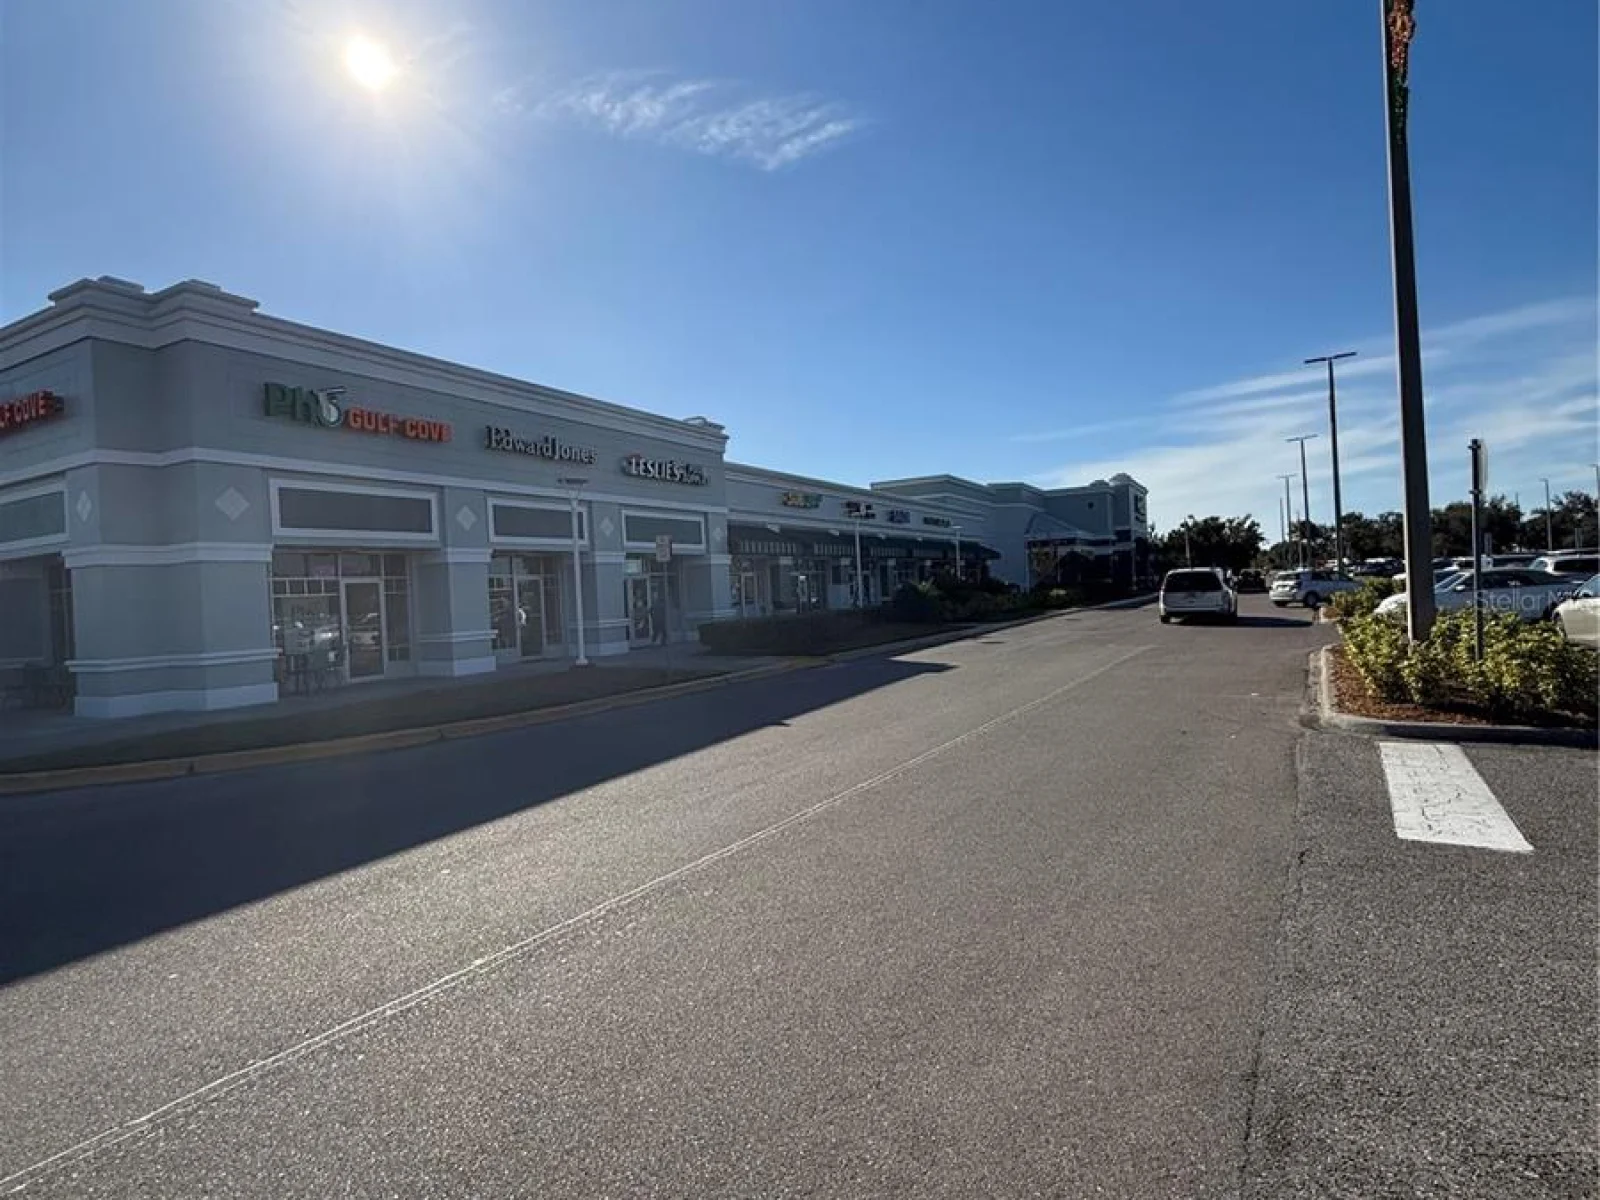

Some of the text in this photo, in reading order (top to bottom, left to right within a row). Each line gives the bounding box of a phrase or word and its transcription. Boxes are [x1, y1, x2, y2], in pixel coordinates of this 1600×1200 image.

[348, 407, 452, 442] GULF COVE
[487, 425, 598, 465] Edward Jones
